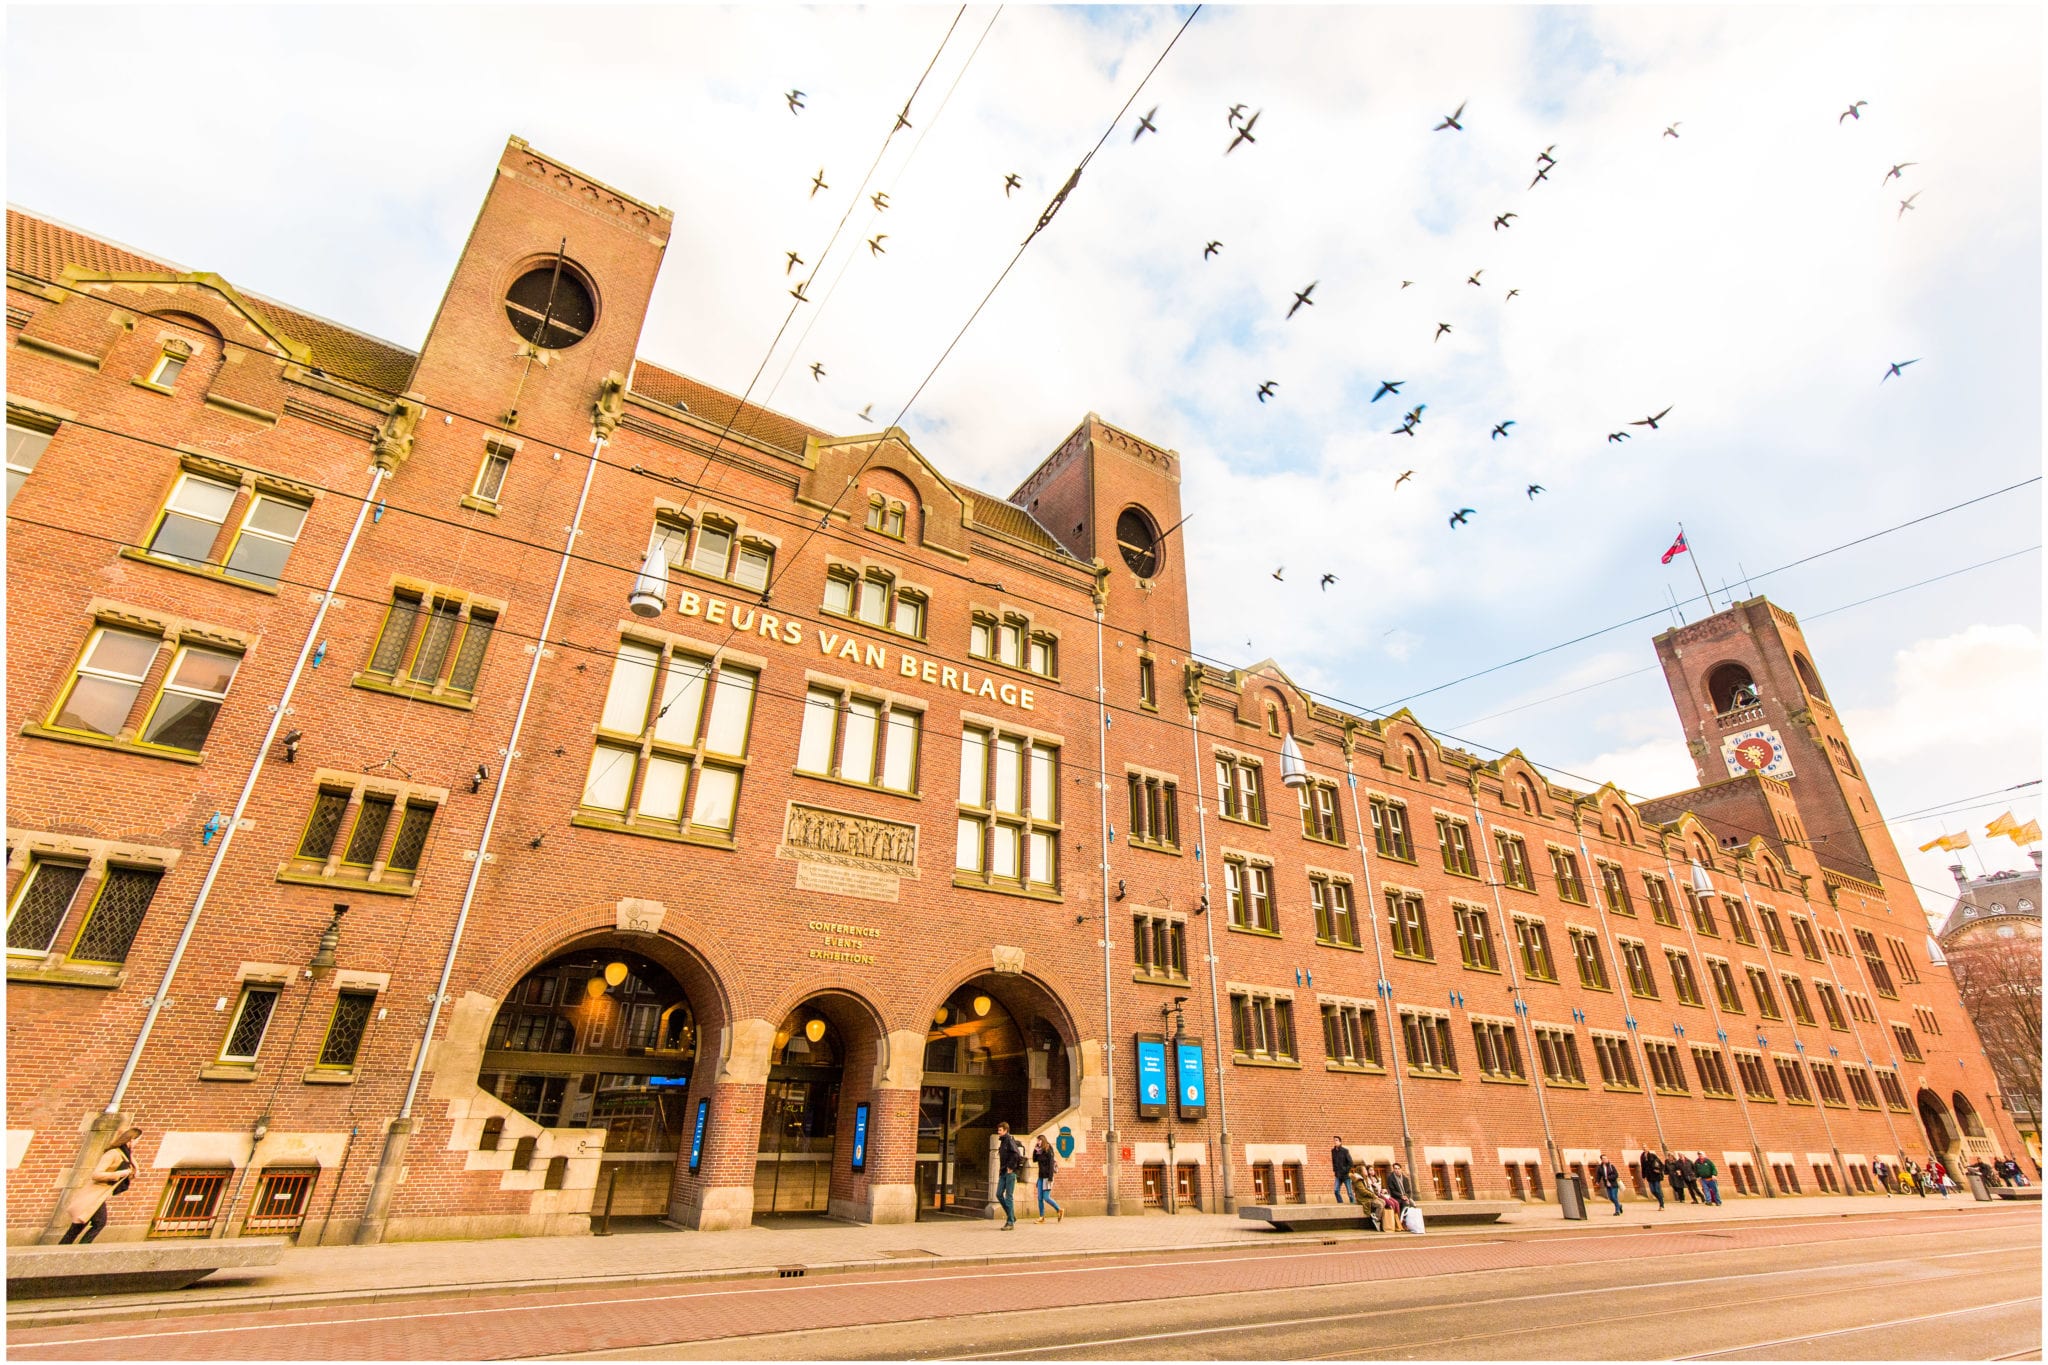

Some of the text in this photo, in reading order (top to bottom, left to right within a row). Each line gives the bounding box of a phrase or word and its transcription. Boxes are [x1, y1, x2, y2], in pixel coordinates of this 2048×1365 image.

[678, 590, 1035, 711] BEURS VAN BERLAGE
[809, 921, 880, 937] CONFERENCES
[824, 936, 863, 949] EVENTS
[809, 949, 875, 965] EXHIBITIONS
